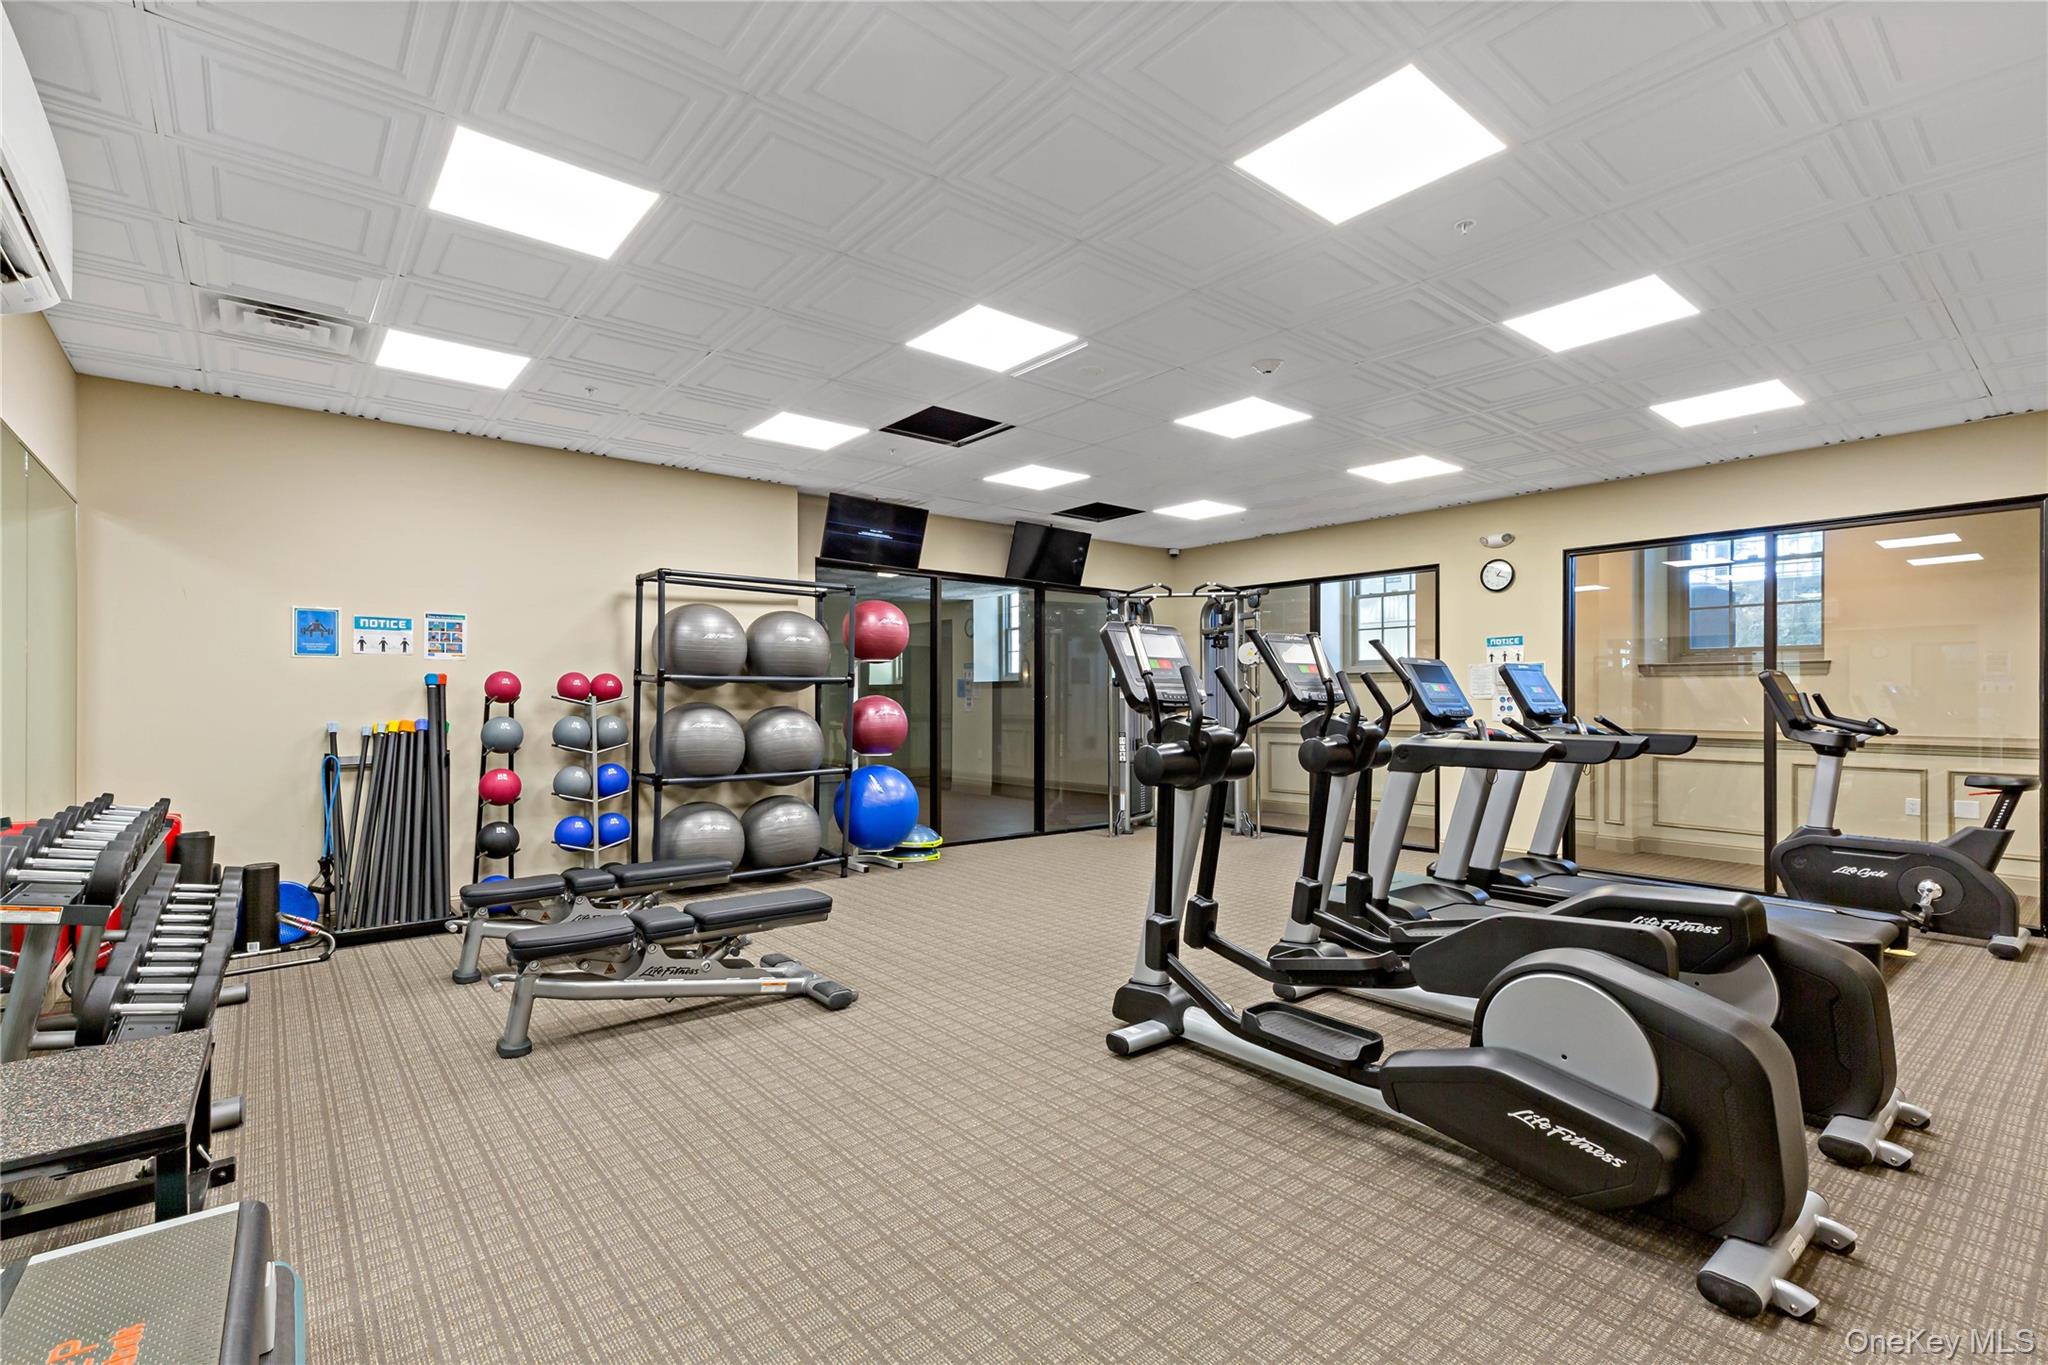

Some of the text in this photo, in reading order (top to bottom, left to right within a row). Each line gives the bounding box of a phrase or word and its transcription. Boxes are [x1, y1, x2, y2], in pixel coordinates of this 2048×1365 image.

[360, 618, 407, 629] NOTICE
[1507, 1109, 1626, 1168] Life Fitness
